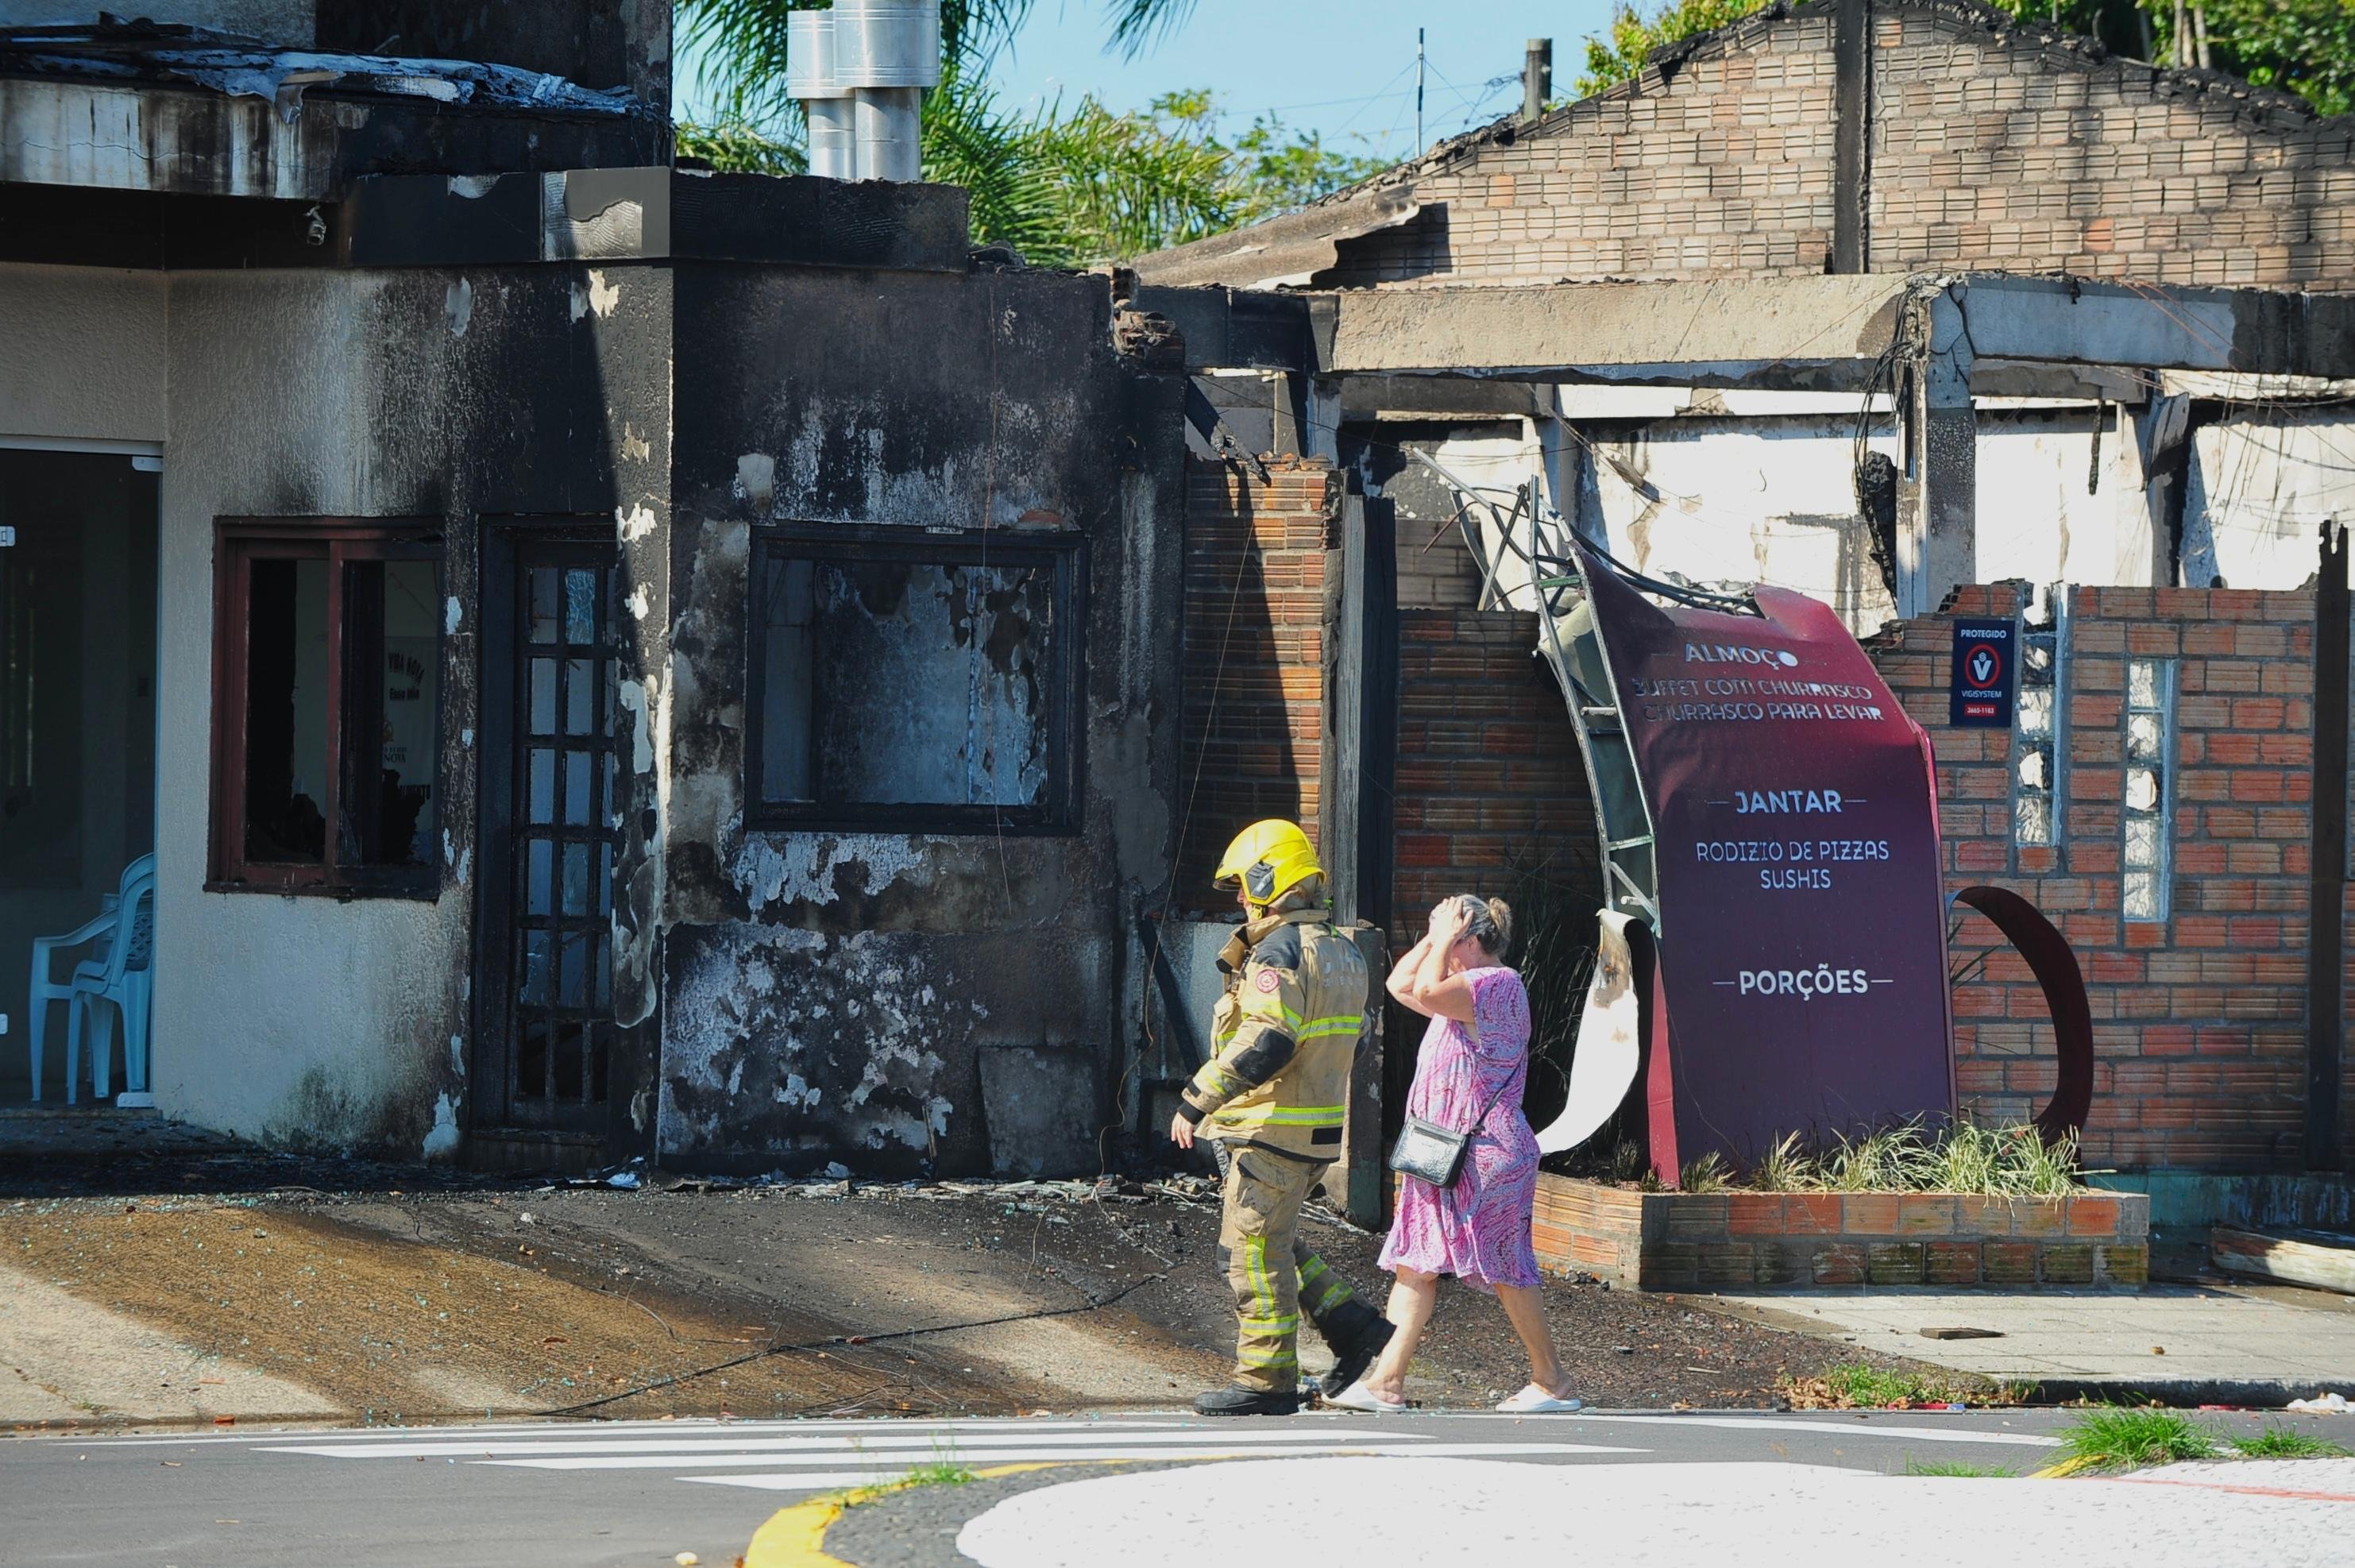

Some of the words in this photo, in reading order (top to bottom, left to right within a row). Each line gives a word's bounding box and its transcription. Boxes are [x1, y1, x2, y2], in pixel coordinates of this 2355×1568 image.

[1960, 629, 2007, 639] PROTEGIDO
[1685, 642, 1798, 670] ALMOÇO
[1632, 678, 1699, 697] BUFFET
[1705, 679, 1755, 696] COM
[1757, 679, 1873, 701] CHURRASCO
[1644, 704, 1764, 722] CHURRASCO
[1769, 704, 1822, 720] PARA
[1826, 704, 1885, 721] LEVAR
[1735, 790, 1843, 813] JANTAR
[1696, 841, 1783, 862] RODIZIO
[1789, 841, 1813, 861] DE
[1819, 840, 1890, 861] PIZZAS
[1760, 869, 1832, 890] SUSHIS
[1739, 964, 1869, 1002] PORÇÕES
